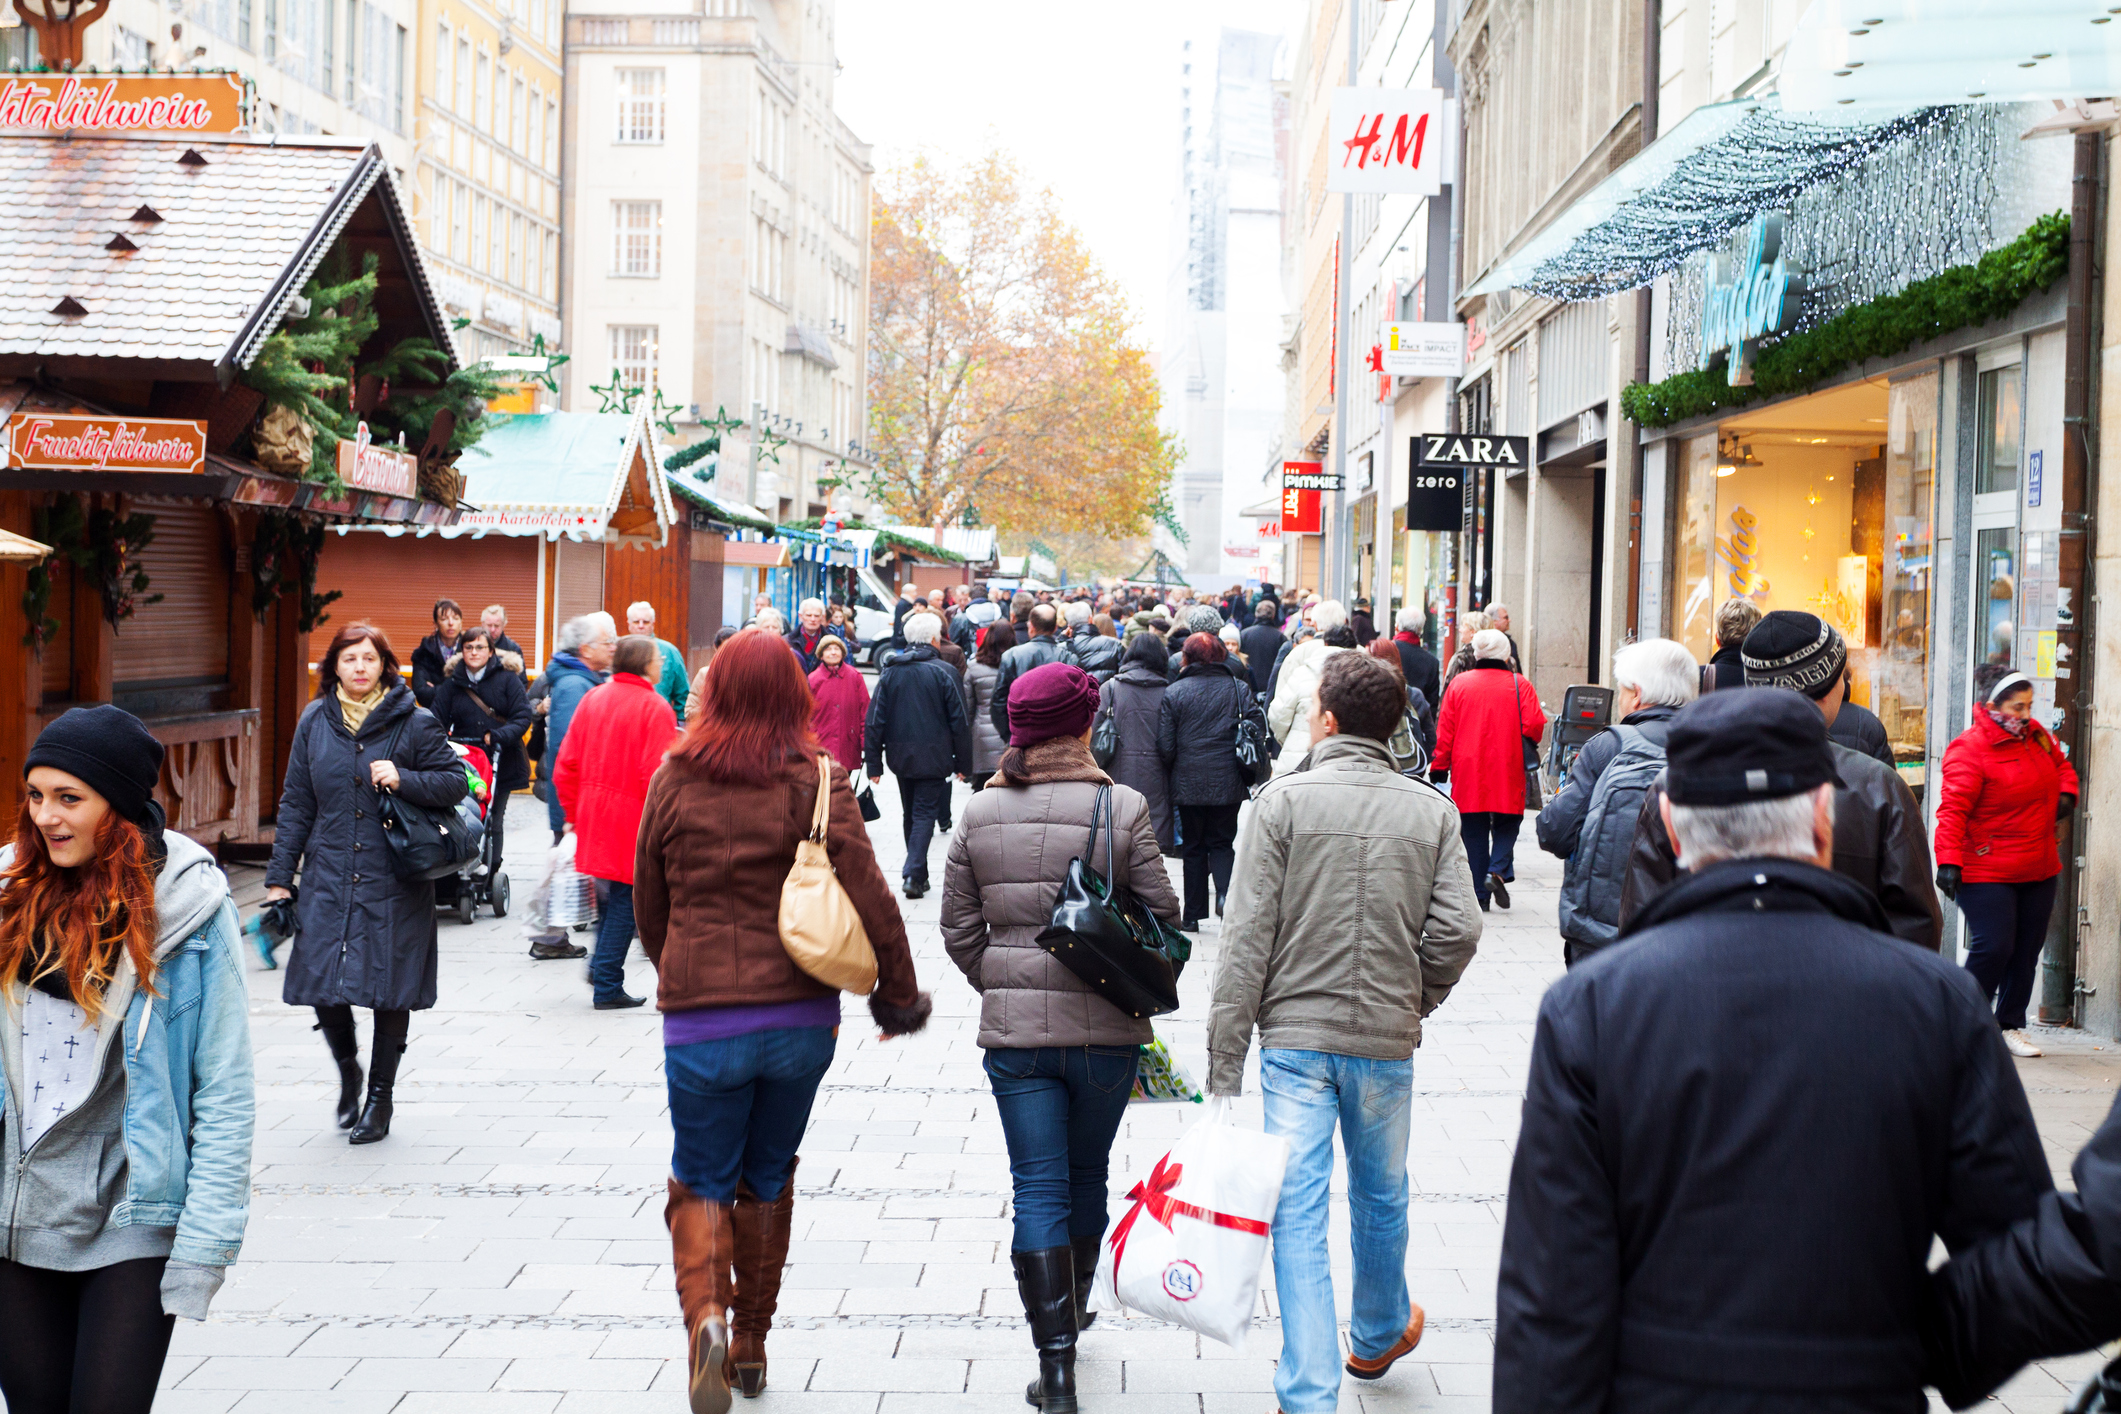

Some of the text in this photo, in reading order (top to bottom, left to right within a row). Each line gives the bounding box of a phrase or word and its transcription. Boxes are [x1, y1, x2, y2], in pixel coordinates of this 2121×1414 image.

[1342, 113, 1429, 170] H&M
[1424, 345, 1457, 353] IMPACT
[23, 420, 194, 470] Fruchtglühwein
[1425, 437, 1519, 464] ZARA
[2030, 457, 2040, 482] 12
[1284, 475, 1339, 489] PIMKIE
[1416, 476, 1457, 489] zero
[499, 511, 571, 526] Kartoffeln
